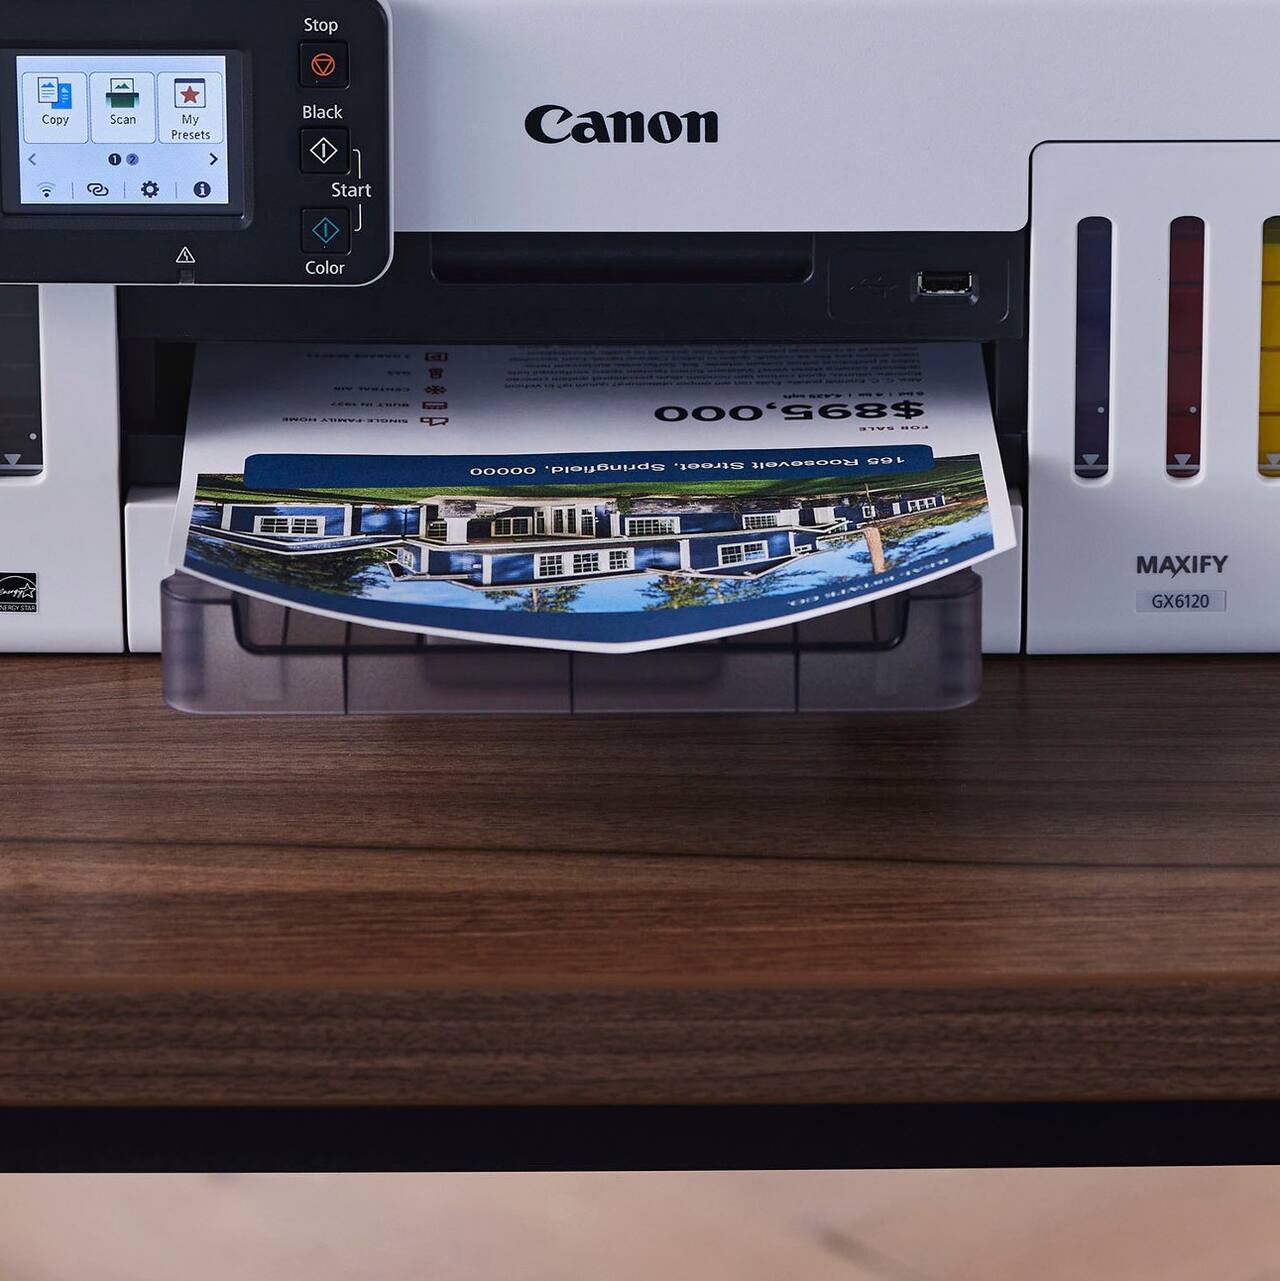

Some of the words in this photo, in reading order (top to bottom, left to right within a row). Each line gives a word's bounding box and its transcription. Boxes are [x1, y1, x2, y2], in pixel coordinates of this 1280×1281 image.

[303, 16, 339, 36] Stop
[109, 113, 137, 125] Scan
[302, 104, 344, 120] Black
[41, 113, 70, 127] Copy
[181, 113, 200, 127] My
[524, 104, 719, 144] Canon
[171, 129, 211, 141] Presets
[331, 182, 372, 199] Start
[305, 259, 346, 277] Color
[653, 400, 926, 422] $895,000
[750, 457, 859, 470] Roosevelt
[866, 455, 906, 466] 165
[468, 466, 536, 477] 00000
[543, 462, 666, 475] Springfield,
[1136, 554, 1229, 579] MAXIFY
[1151, 593, 1210, 610] GX6120
